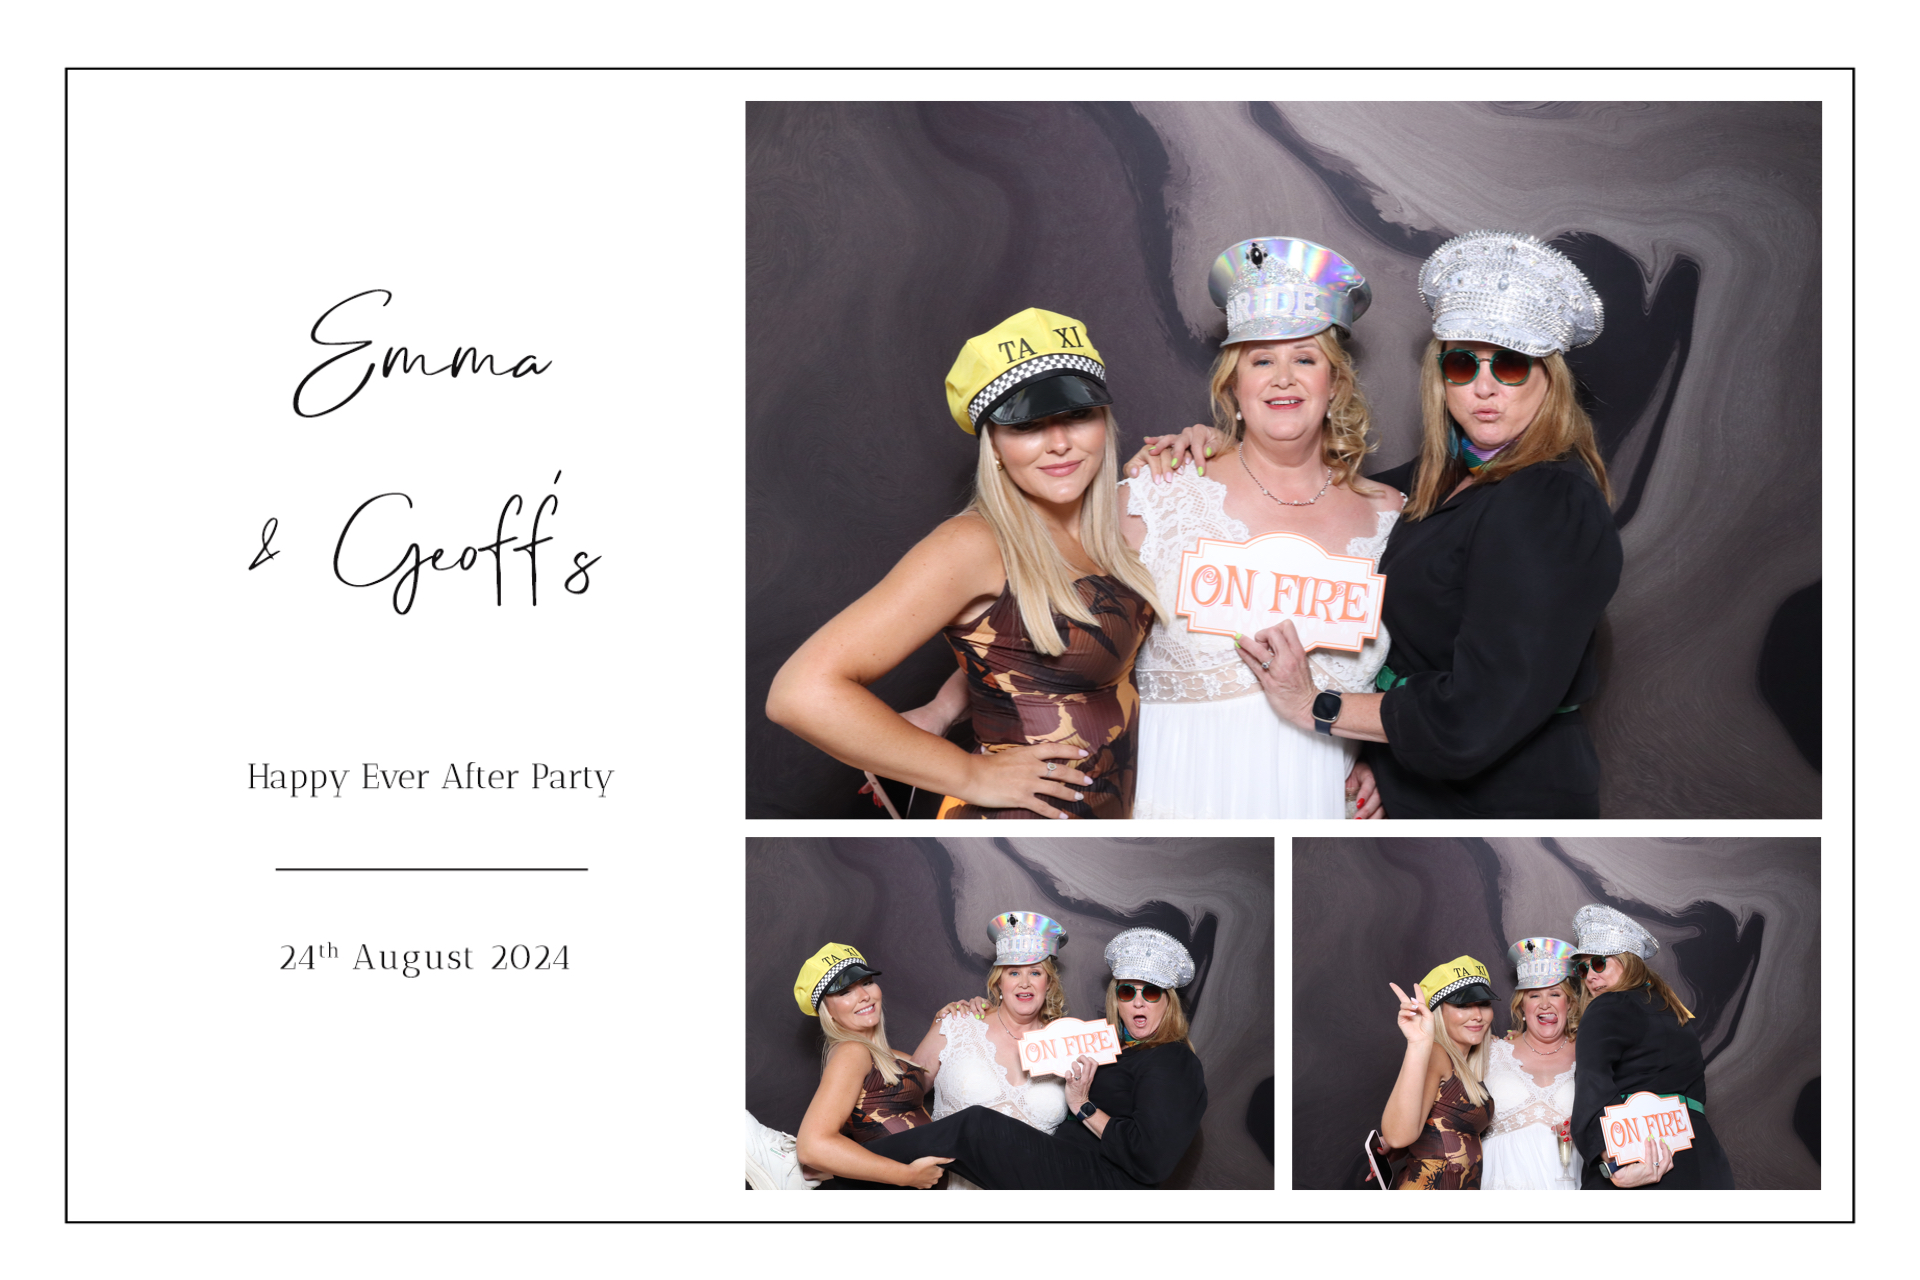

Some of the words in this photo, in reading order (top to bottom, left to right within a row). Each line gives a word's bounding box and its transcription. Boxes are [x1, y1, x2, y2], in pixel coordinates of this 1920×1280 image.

[1191, 564, 1260, 611] ON
[1268, 571, 1370, 624] FIRE
[1025, 1038, 1057, 1063] ON
[1061, 1030, 1114, 1056] FIRE
[1610, 1117, 1641, 1148] ON
[1642, 1109, 1688, 1138] FIRE
